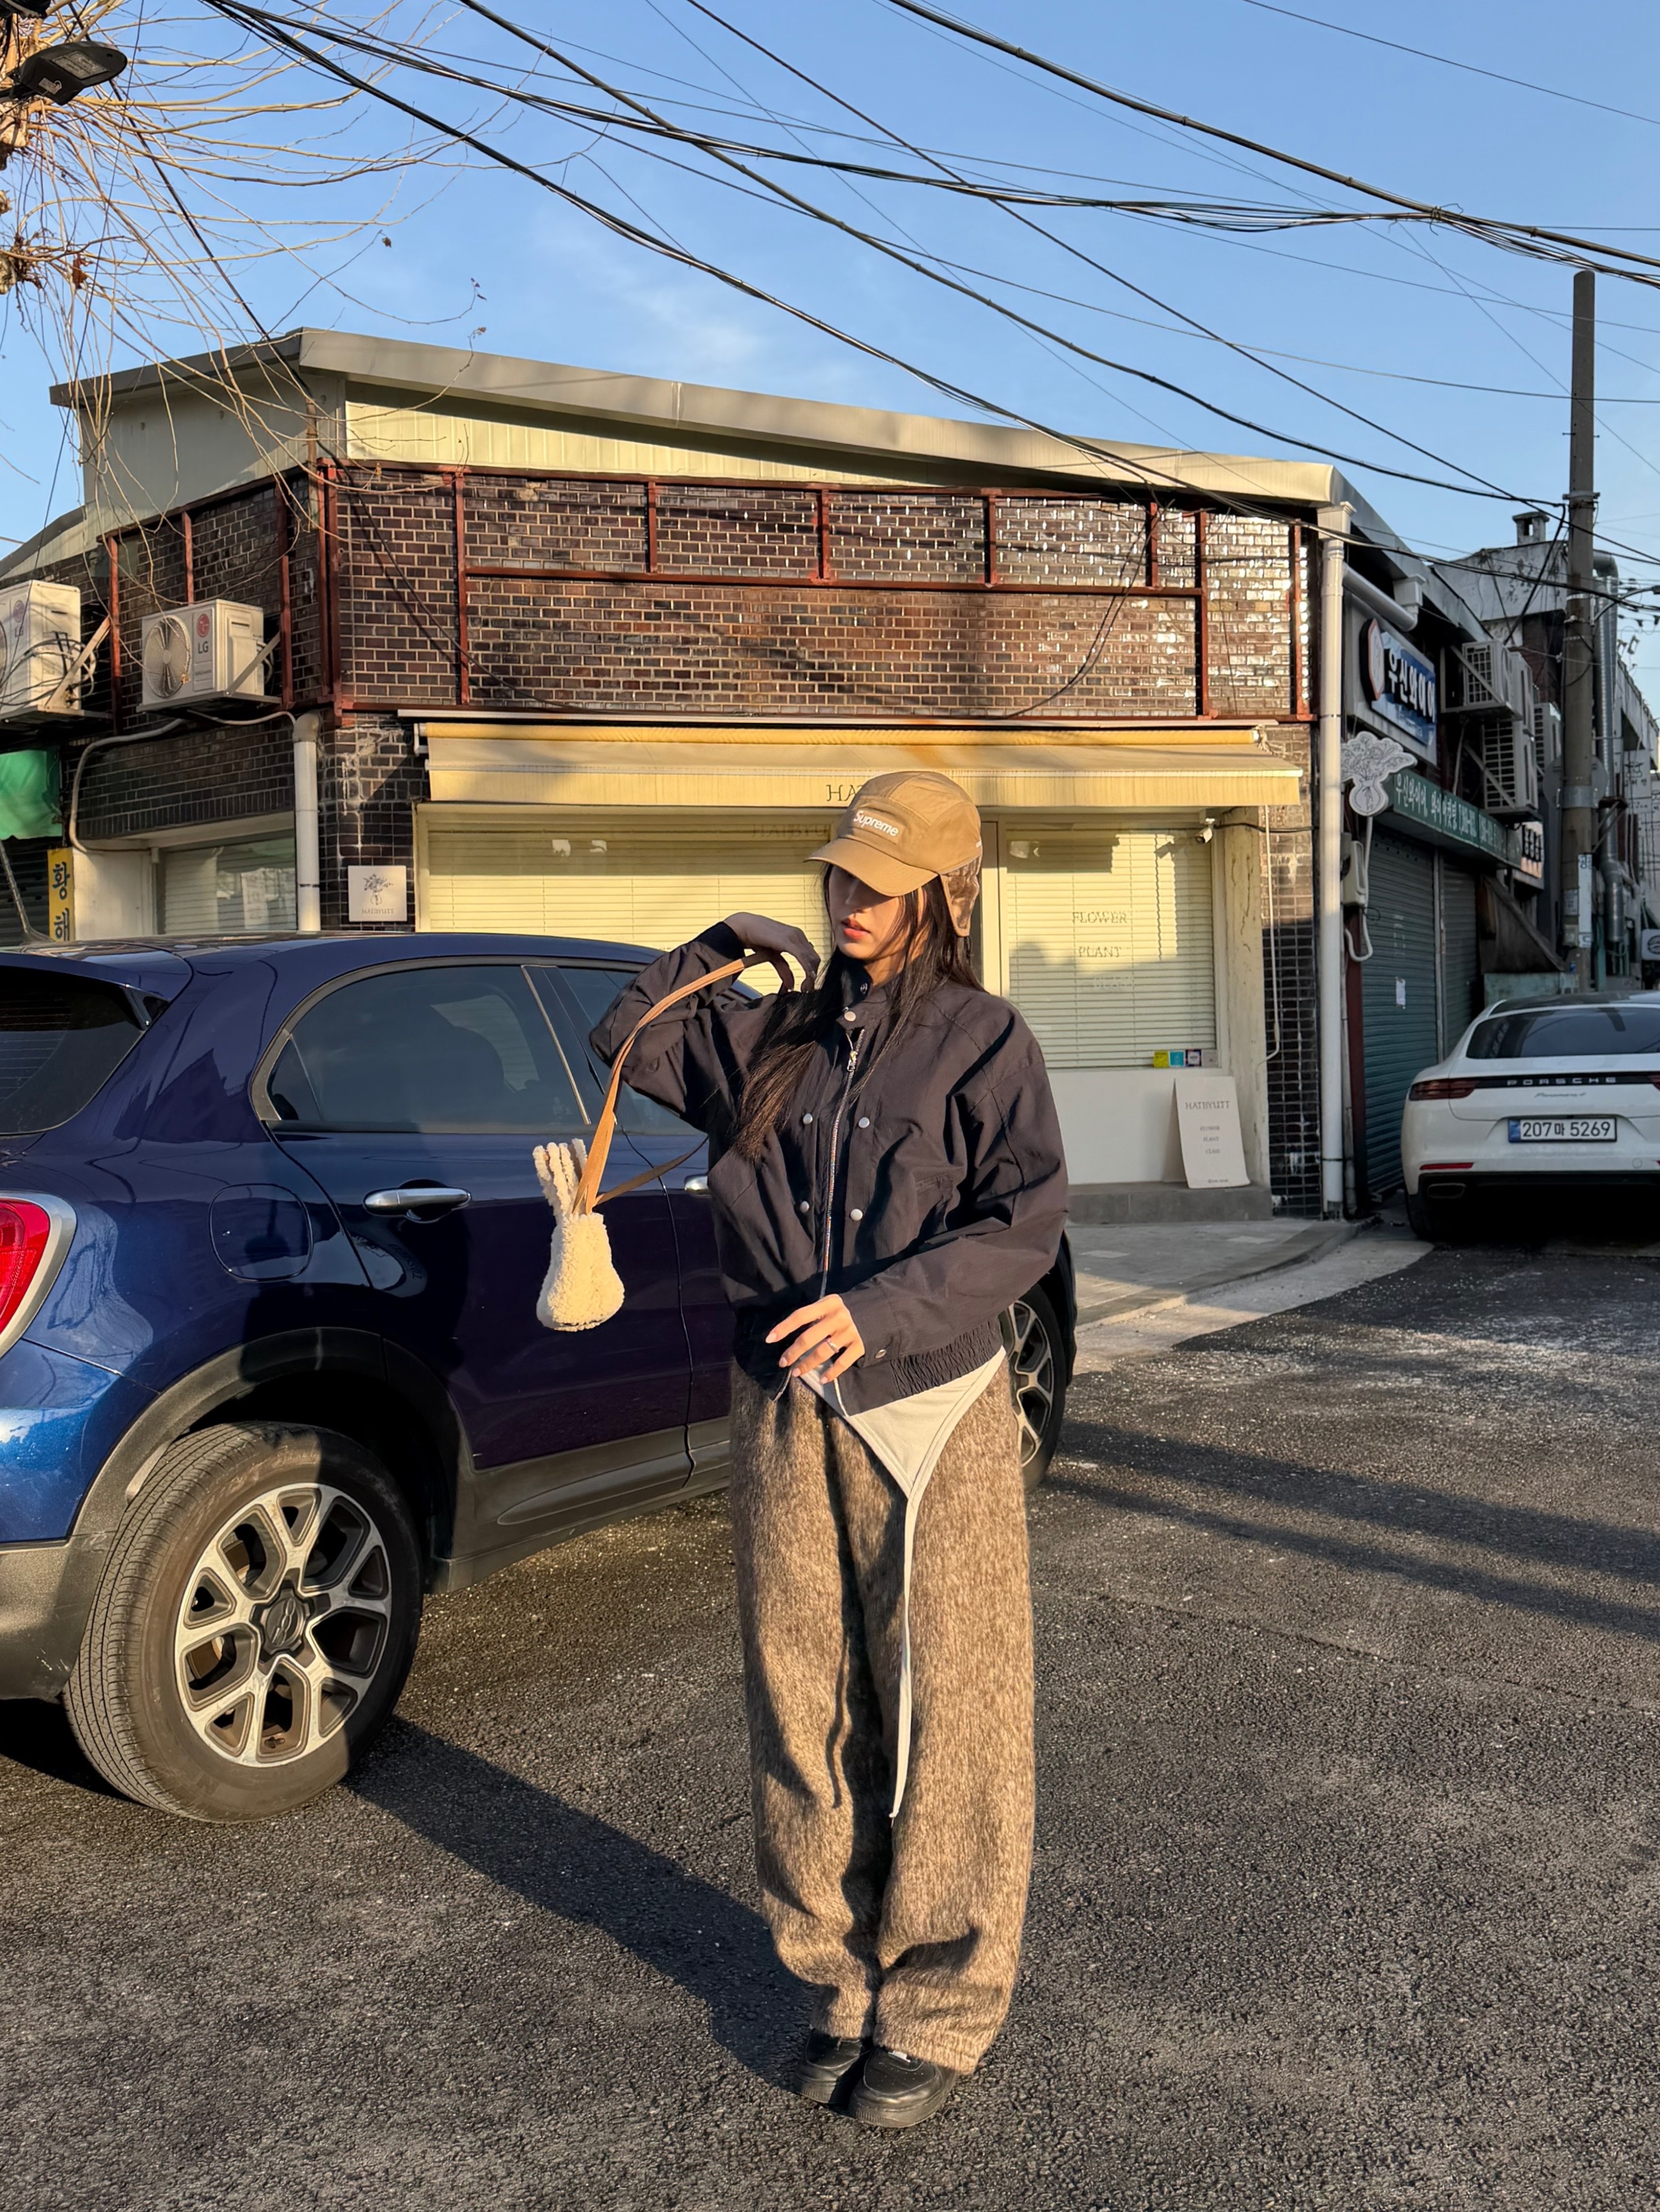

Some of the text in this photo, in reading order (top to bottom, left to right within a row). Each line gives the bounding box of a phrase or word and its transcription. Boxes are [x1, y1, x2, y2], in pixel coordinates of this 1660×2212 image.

[198, 641, 209, 654] LG
[1388, 648, 1435, 724] 우신와이어
[853, 810, 899, 837] Supreme
[1072, 911, 1128, 923] FLOWER
[1078, 946, 1122, 958] PLANT
[1507, 1077, 1616, 1087] PORSCHE
[1523, 1121, 1611, 1137] 207마 5269
